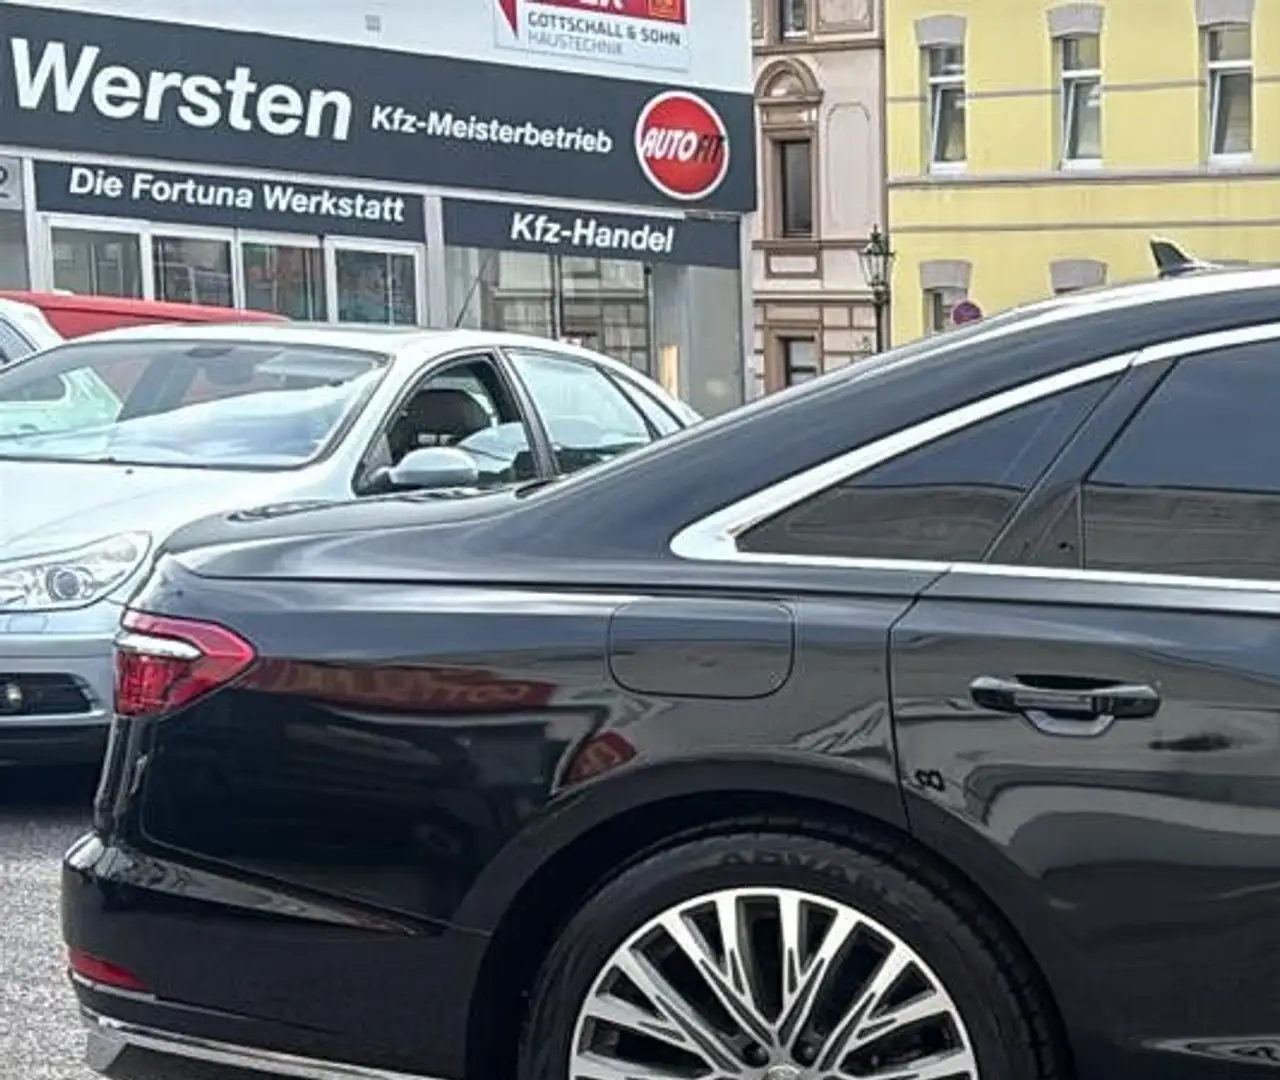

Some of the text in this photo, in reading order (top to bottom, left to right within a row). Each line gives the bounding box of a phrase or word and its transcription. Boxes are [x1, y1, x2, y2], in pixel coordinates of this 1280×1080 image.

[641, 30, 680, 46] SOHN
[11, 37, 351, 141] Wersten
[372, 106, 612, 154] Kfz-Meisterbetrieb
[69, 167, 404, 222] Die Fortuna Werkstatt
[511, 213, 674, 252] Kfz-Handel
